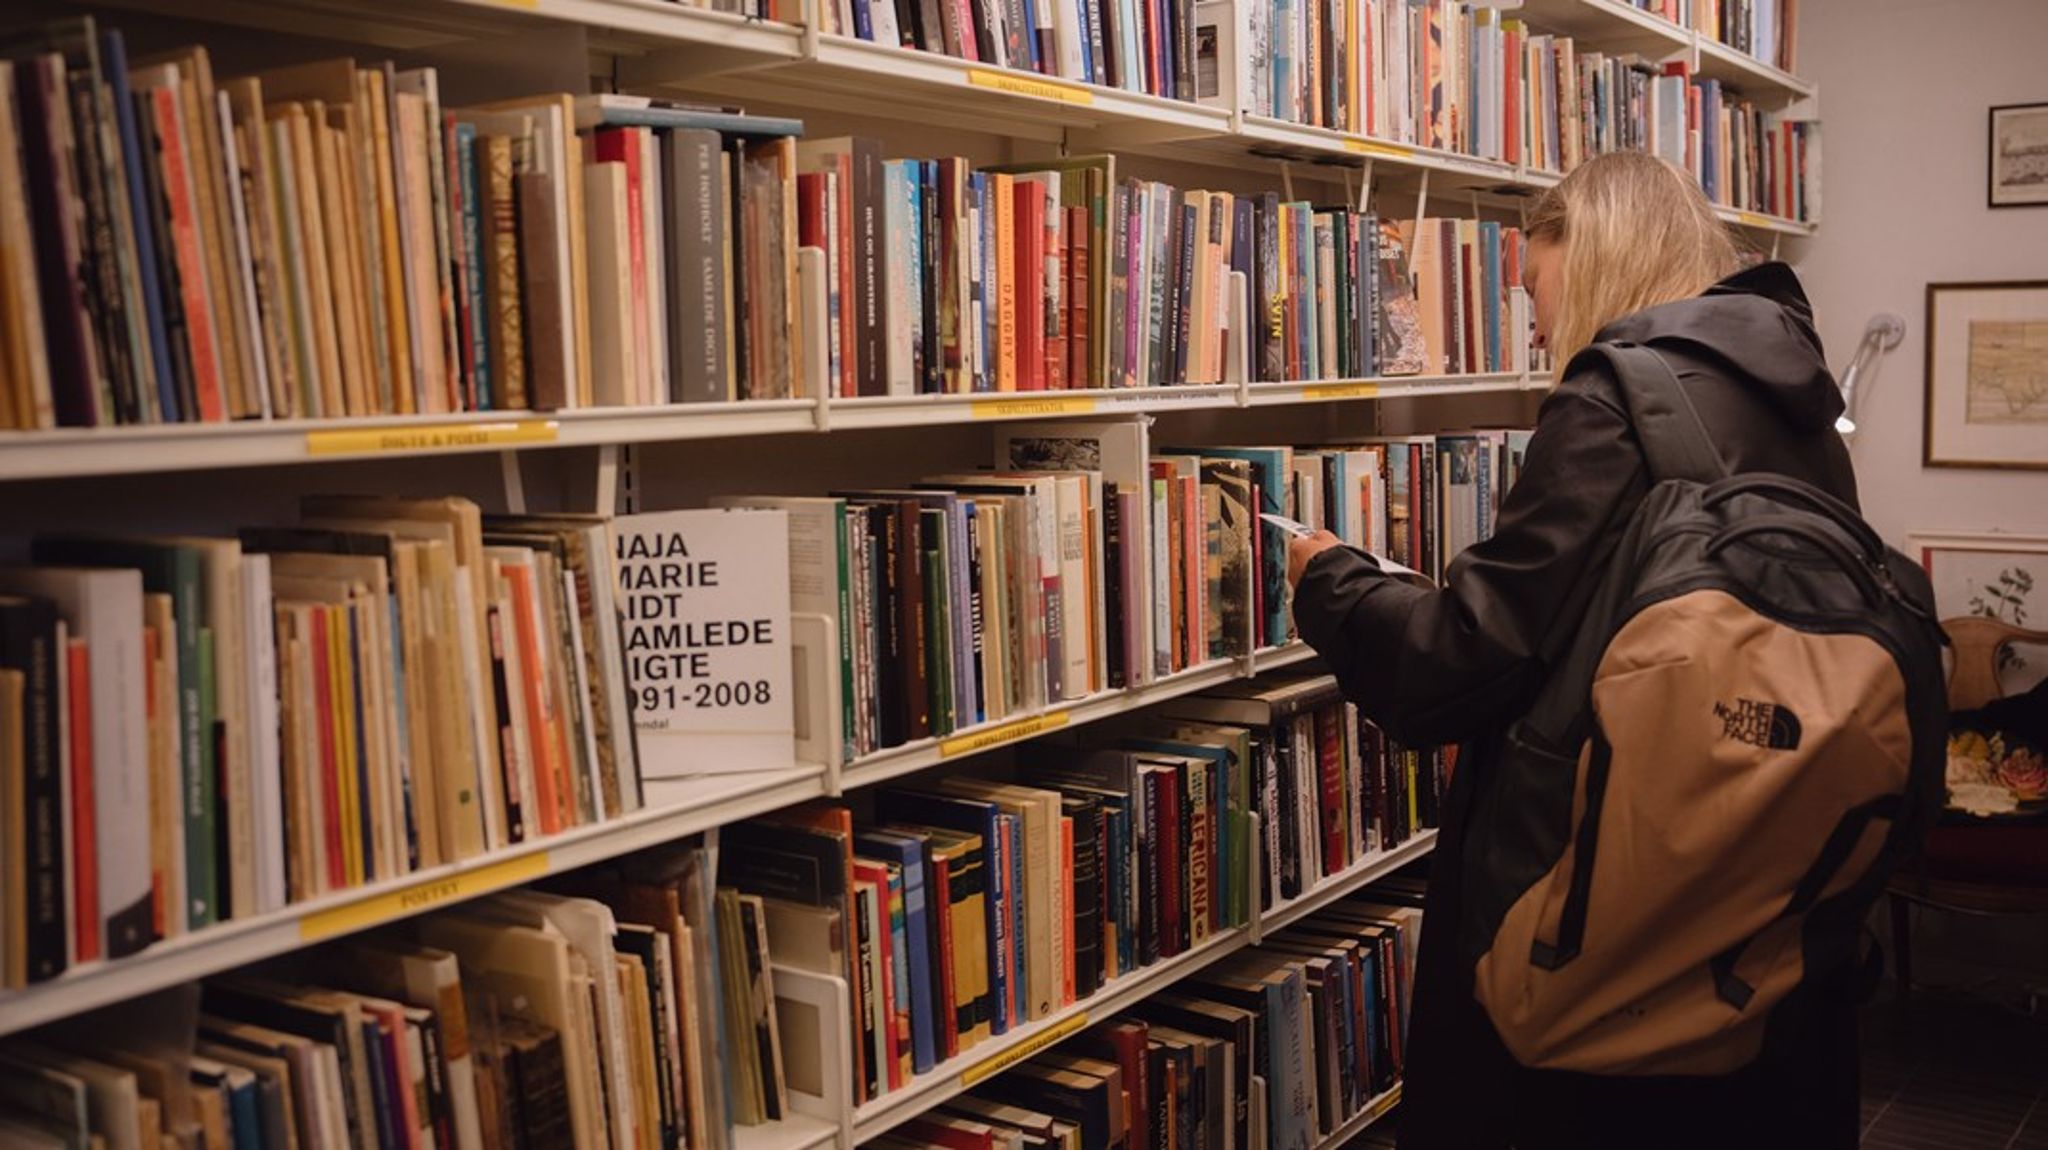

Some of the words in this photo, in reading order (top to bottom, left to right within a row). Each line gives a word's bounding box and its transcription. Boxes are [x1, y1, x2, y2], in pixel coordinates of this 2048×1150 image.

[1003, 283, 1012, 360] DAGGRY
[1272, 293, 1282, 337] SVIN
[628, 594, 683, 620] IDT
[626, 619, 774, 650] AMLEDE
[633, 653, 711, 681] IGTE
[628, 680, 772, 711] 91-2008
[1736, 698, 1774, 717] THE
[1713, 701, 1770, 734] NORTH
[1722, 722, 1769, 748] FACE
[1192, 813, 1206, 918] AFRICANA
